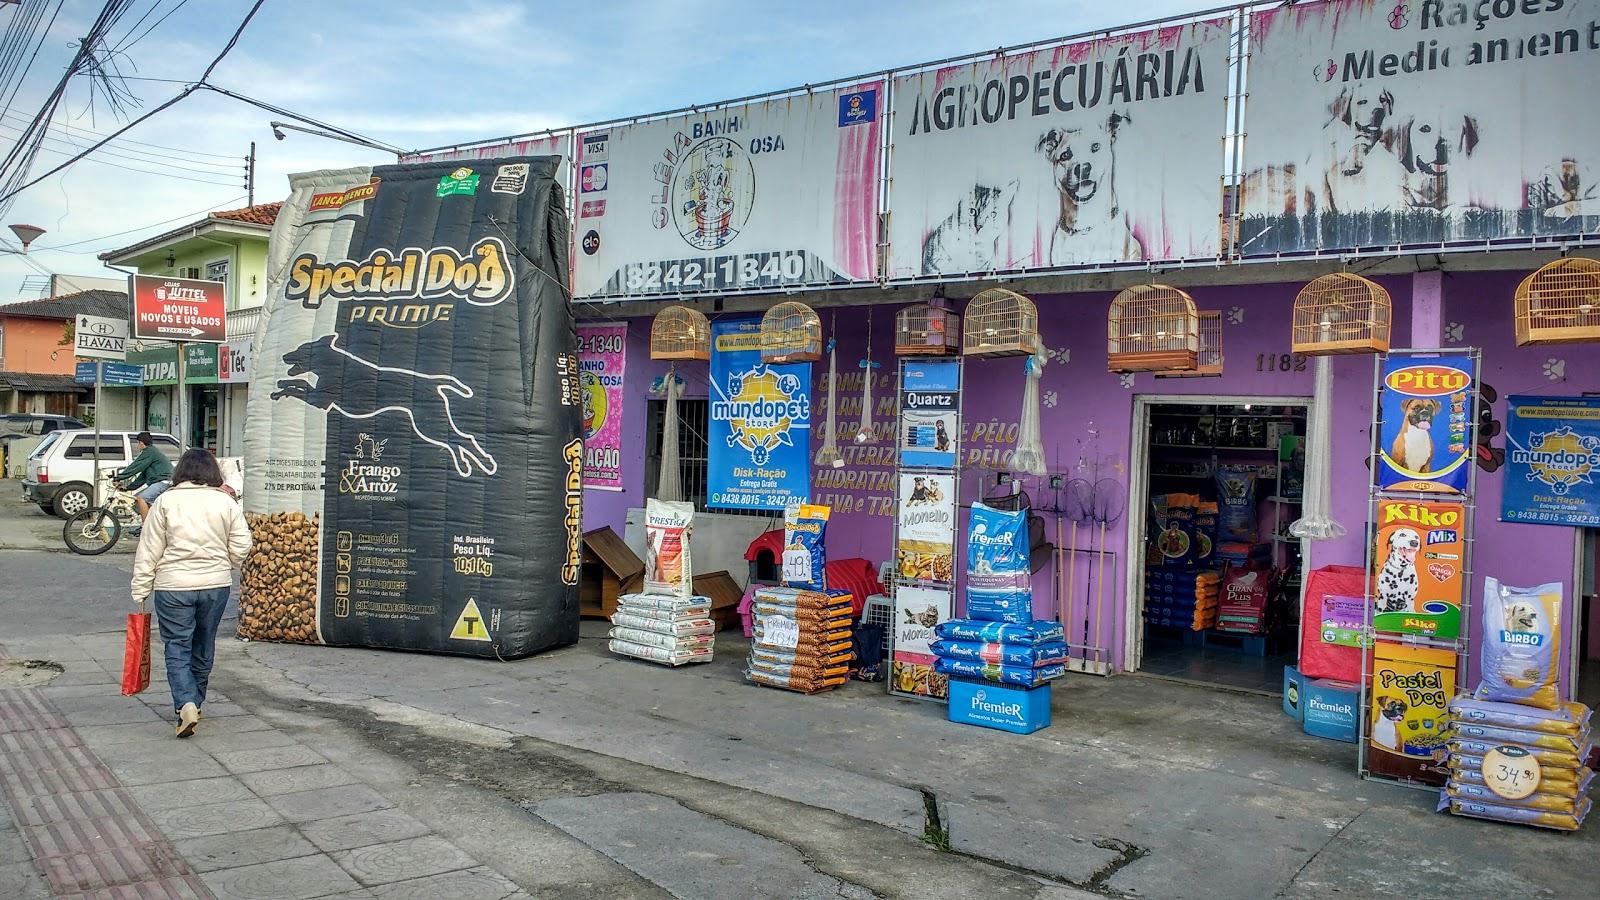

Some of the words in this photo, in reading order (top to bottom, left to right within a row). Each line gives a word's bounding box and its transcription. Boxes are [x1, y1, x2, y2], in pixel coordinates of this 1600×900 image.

[909, 47, 1205, 136] AGROPECUÁRIA
[588, 143, 604, 154] VISA
[750, 135, 785, 155] OSA
[312, 186, 374, 208] LANÇAMENTO
[584, 237, 599, 248] elo
[289, 254, 417, 305] Special
[426, 243, 506, 300] Dog
[168, 287, 207, 299] JUTTEL
[163, 302, 199, 316] MÓVEIS
[350, 304, 454, 325] PRIME
[141, 312, 173, 324] NOVOS
[176, 314, 182, 324] E
[184, 315, 221, 327] USADOS
[78, 335, 124, 350] HAVAN
[579, 361, 605, 371] ANHO
[1256, 354, 1306, 372] 1182
[598, 376, 622, 386] TOSA
[1391, 370, 1464, 389] Pitú
[561, 379, 571, 406] Peso
[907, 392, 951, 409] Quartz
[711, 393, 810, 422] mundopet
[971, 417, 1020, 443] PÊLO
[584, 446, 620, 471] AÇÃO
[1513, 449, 1600, 468] mundope
[349, 460, 401, 482] Frango
[733, 467, 786, 480] Disk-Ração
[277, 483, 284, 491] DE
[340, 468, 360, 493] &
[356, 477, 398, 493] Arroz
[721, 493, 760, 505] 8438.8015
[1225, 497, 1247, 506] BIRBO
[904, 509, 949, 528] Monello
[1385, 503, 1458, 527] Kiko
[1517, 511, 1559, 521] 8438.8015
[380, 533, 387, 545] 3
[391, 533, 398, 545] 6
[465, 536, 495, 544] Brasileira
[1429, 530, 1455, 544] Mix
[453, 544, 474, 555] Peso
[1226, 583, 1252, 593] GRAN
[1227, 592, 1251, 601] PLUS
[463, 617, 479, 634] T
[1405, 618, 1436, 629] Kiko
[1505, 631, 1540, 645] BIRBO
[1380, 670, 1442, 689] Pastel
[1406, 690, 1447, 709] Dog
[972, 697, 1024, 721] PremieR
[1310, 700, 1353, 718] PremieR
